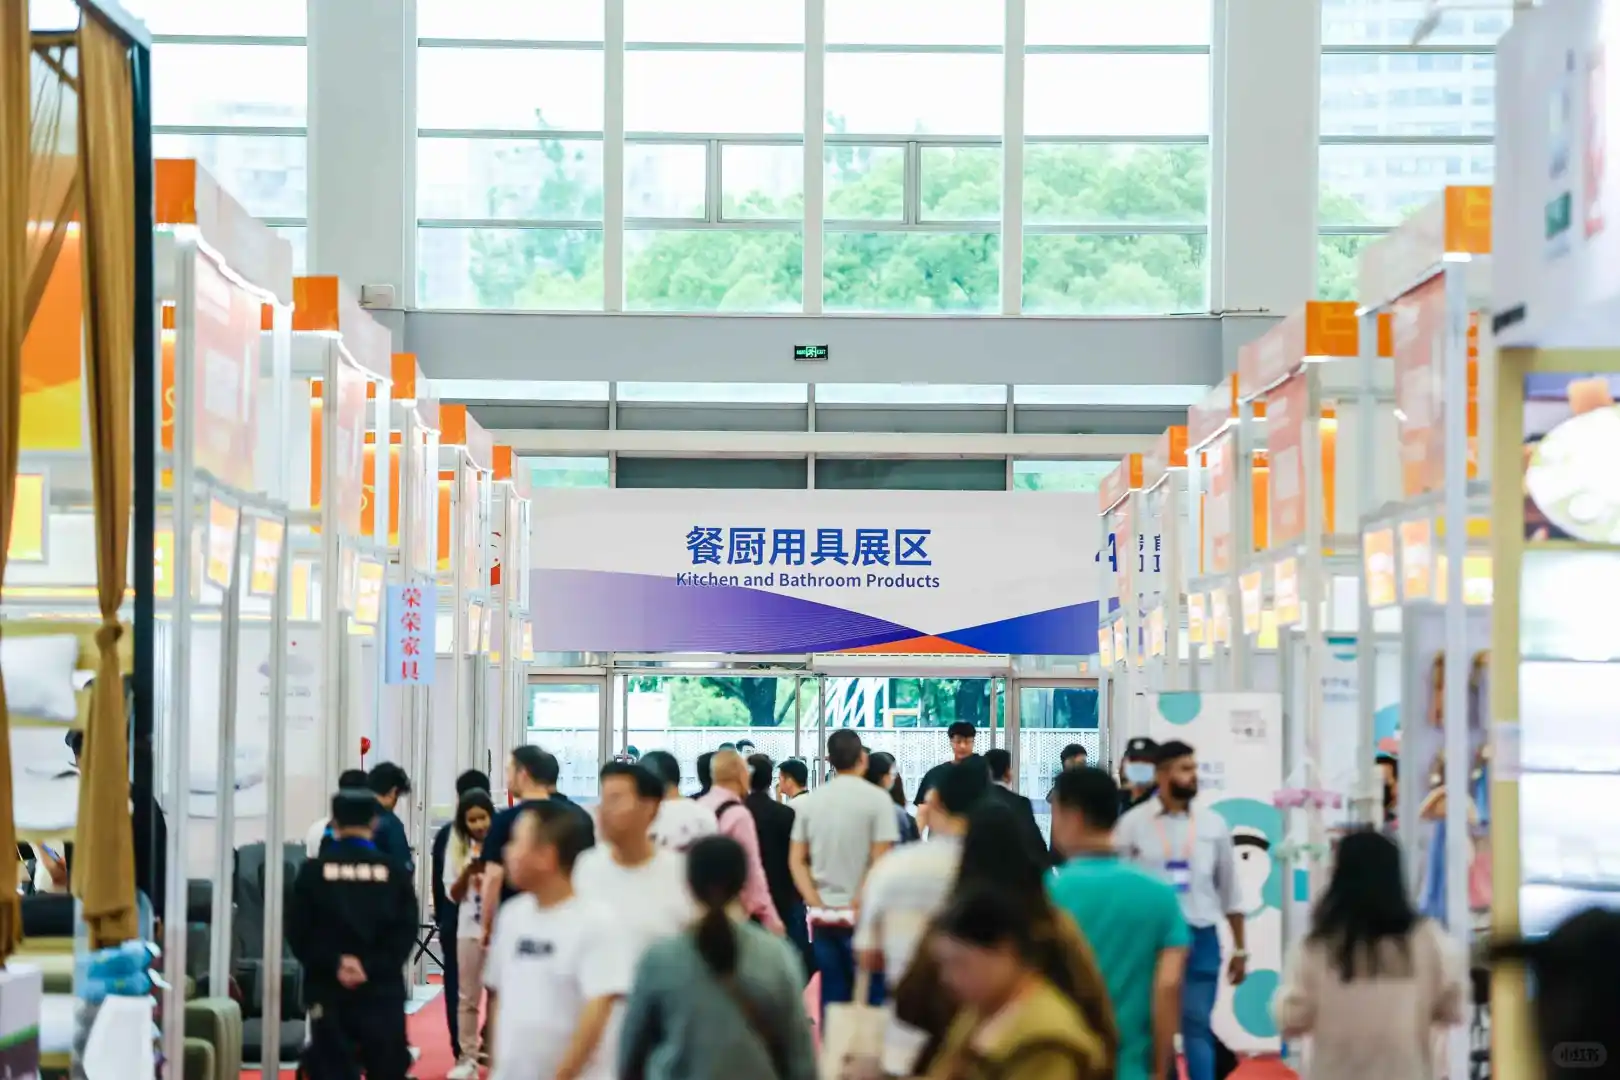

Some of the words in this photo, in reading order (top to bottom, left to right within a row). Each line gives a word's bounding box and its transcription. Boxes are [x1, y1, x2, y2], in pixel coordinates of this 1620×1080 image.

[686, 525, 932, 567] 餐厨用具展区
[676, 572, 739, 587] Kitchen
[743, 572, 774, 587] and
[779, 572, 861, 588] Bathroom
[866, 573, 940, 588] Products
